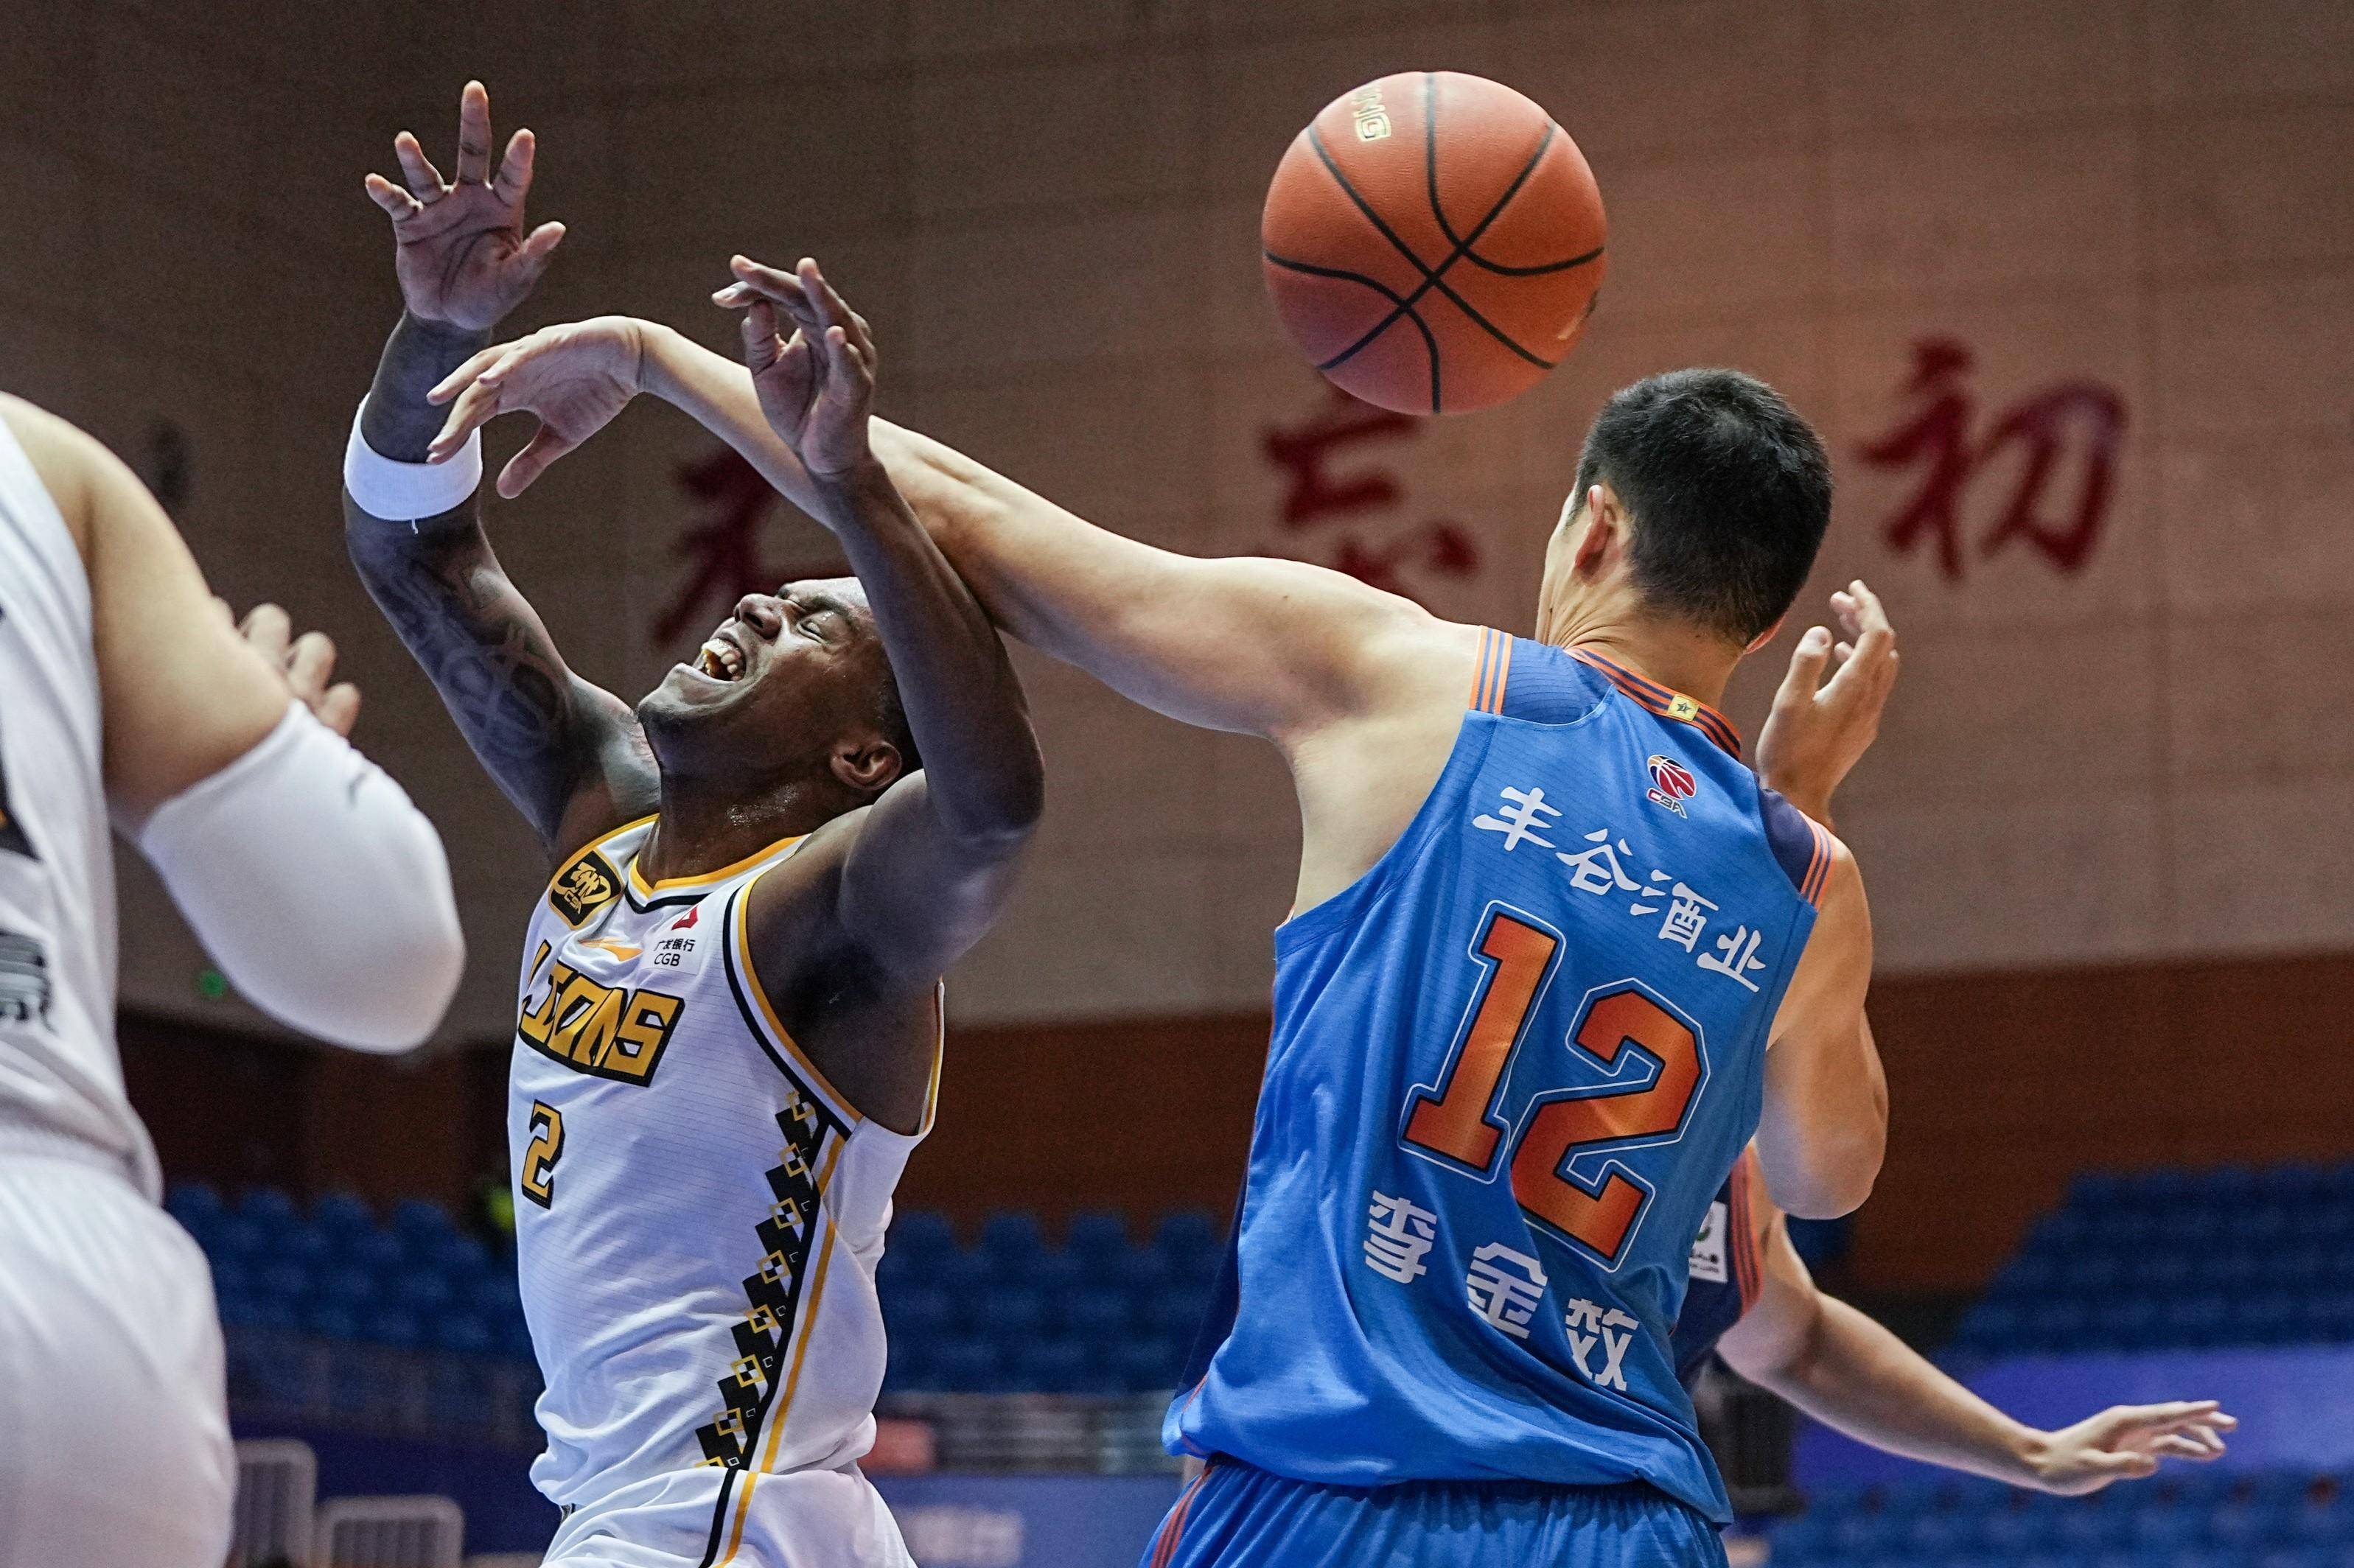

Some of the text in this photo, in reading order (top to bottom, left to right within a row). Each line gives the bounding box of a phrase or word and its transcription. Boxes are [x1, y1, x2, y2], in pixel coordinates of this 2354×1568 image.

[1646, 788, 1688, 819] CBA
[1473, 785, 1767, 993] 丰谷酒业
[653, 938, 696, 953] 广发银行
[654, 953, 681, 967] CGB
[1399, 900, 1711, 1273] 12
[521, 1099, 566, 1210] 2
[1363, 1189, 1640, 1391] 李金效
